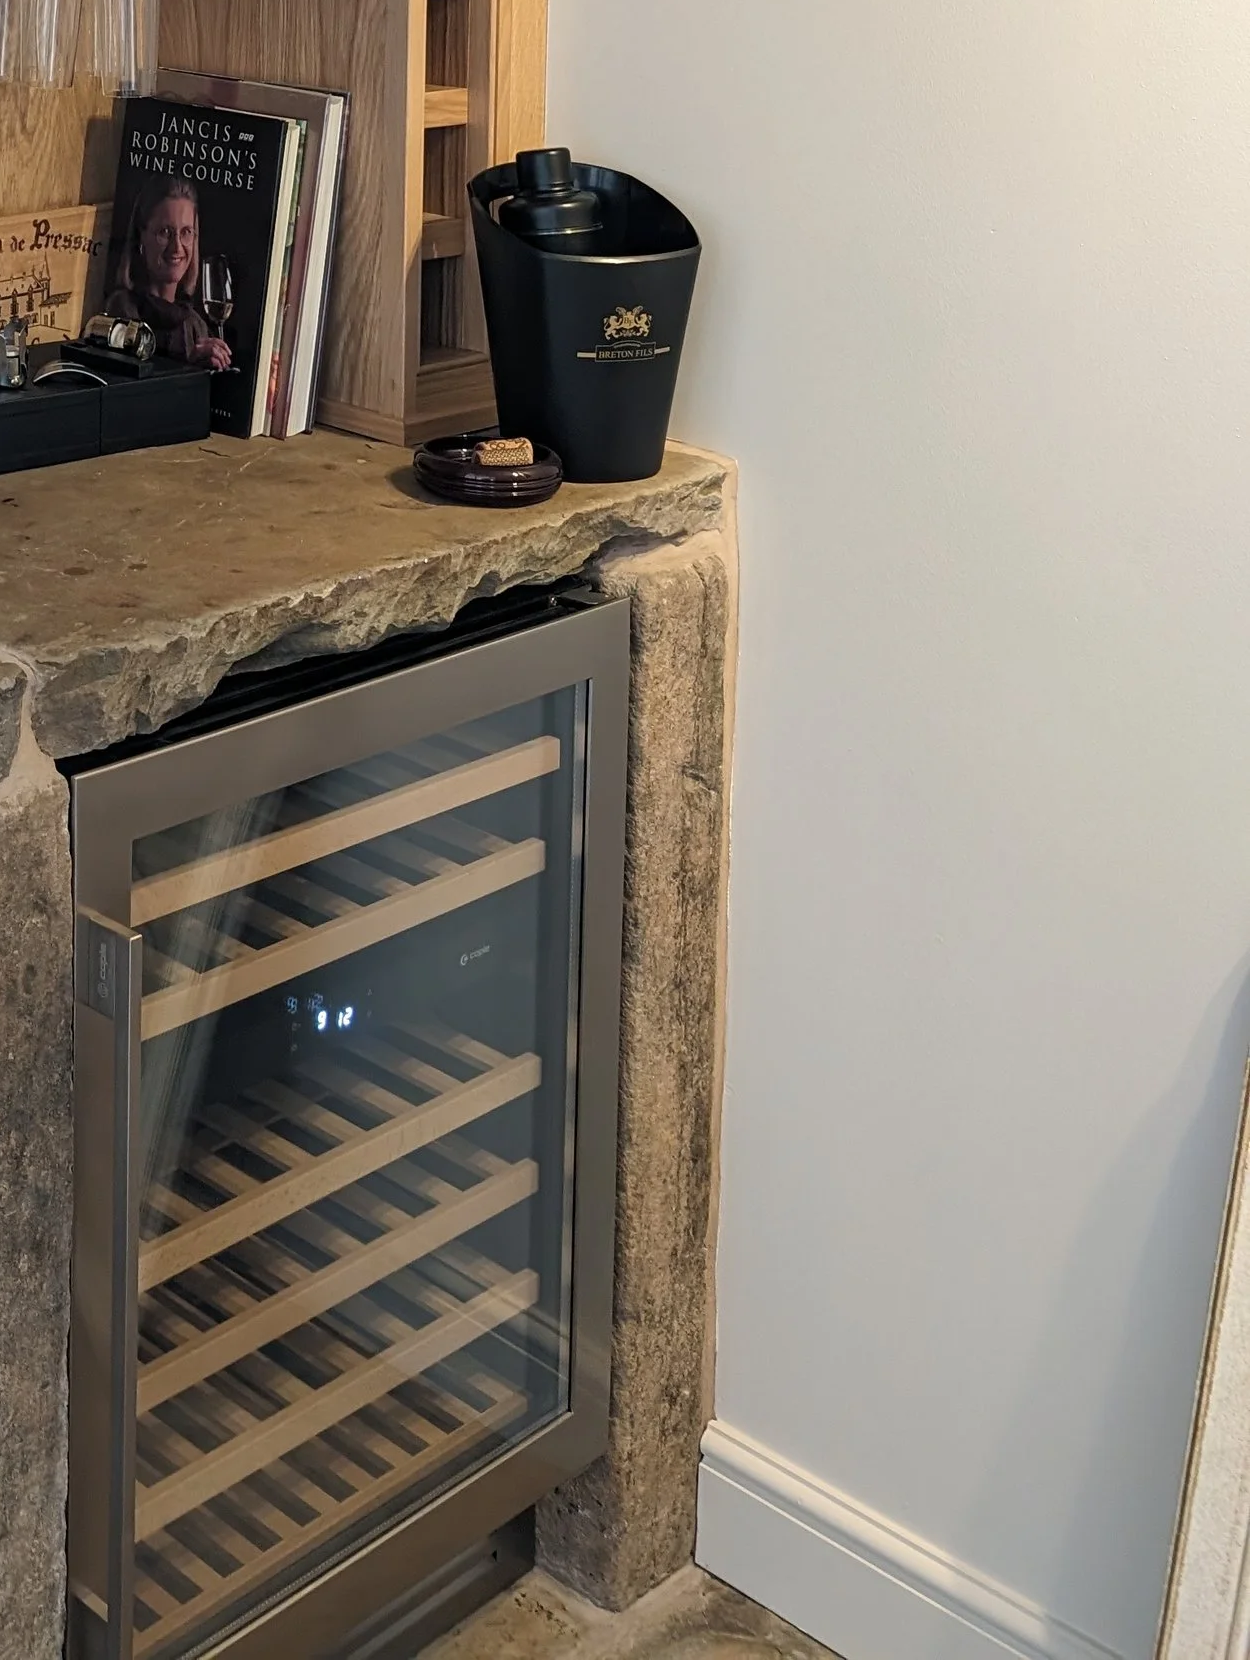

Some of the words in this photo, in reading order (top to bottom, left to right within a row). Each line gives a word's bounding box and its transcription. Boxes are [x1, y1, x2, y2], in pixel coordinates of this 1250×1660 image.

[158, 112, 231, 142] JANCIS
[131, 130, 257, 170] ROBINSON'S
[129, 151, 176, 175] WINE
[182, 162, 255, 191] COURSE
[9, 235, 26, 253] de
[598, 350, 634, 359] BRETON
[635, 349, 653, 357] FILS
[317, 1010, 327, 1030] 9
[338, 1006, 353, 1028] 12
